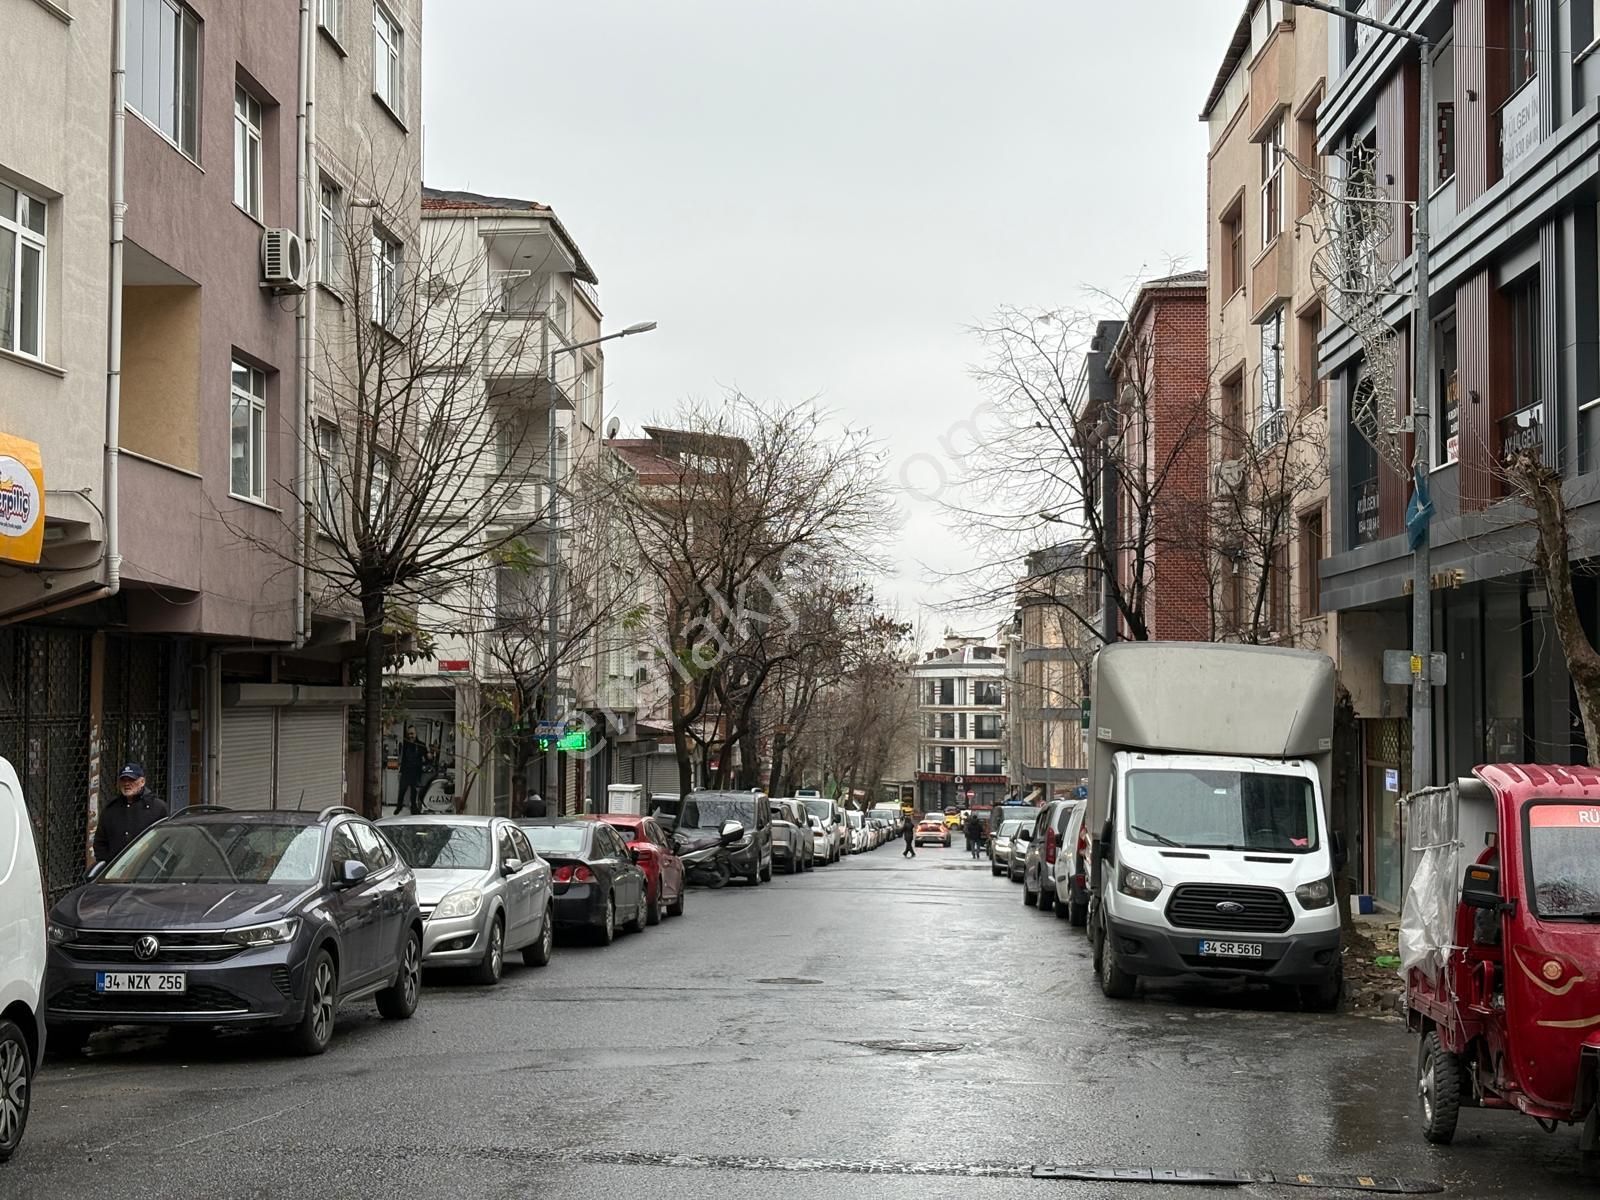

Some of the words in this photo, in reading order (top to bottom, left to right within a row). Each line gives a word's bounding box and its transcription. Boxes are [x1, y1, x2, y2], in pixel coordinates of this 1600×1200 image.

[0, 488, 29, 520] rpiliç
[1204, 942, 1217, 953] 34
[1219, 942, 1235, 954] SR
[1237, 944, 1261, 955] 5616
[105, 975, 120, 989] 34
[127, 975, 151, 989] NZK
[158, 976, 182, 989] 256
